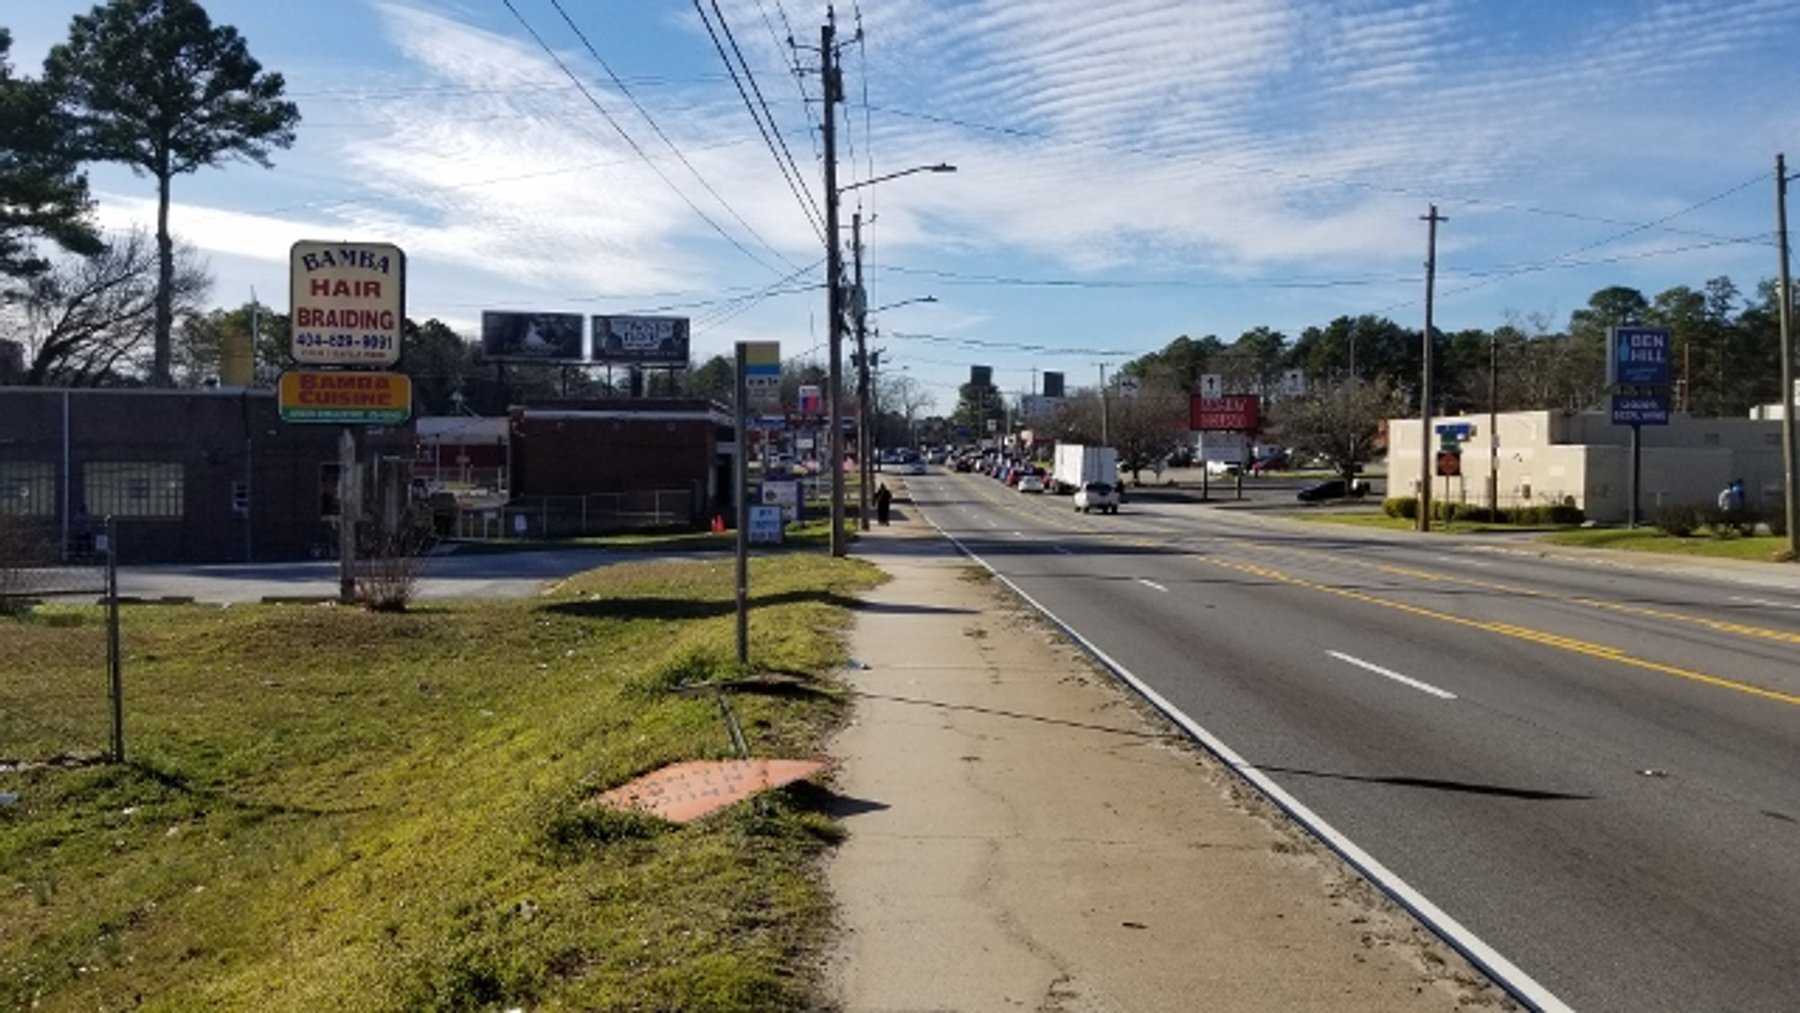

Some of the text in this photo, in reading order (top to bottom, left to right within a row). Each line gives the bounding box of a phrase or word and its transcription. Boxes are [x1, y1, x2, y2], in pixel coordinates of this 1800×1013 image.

[302, 250, 389, 274] BAMBA
[310, 279, 382, 298] HAIR
[297, 307, 395, 330] BRAIDING
[1631, 334, 1664, 348] BEN
[1631, 349, 1665, 362] HILL
[299, 374, 391, 390] BAMBA
[298, 391, 393, 406] CUISINE
